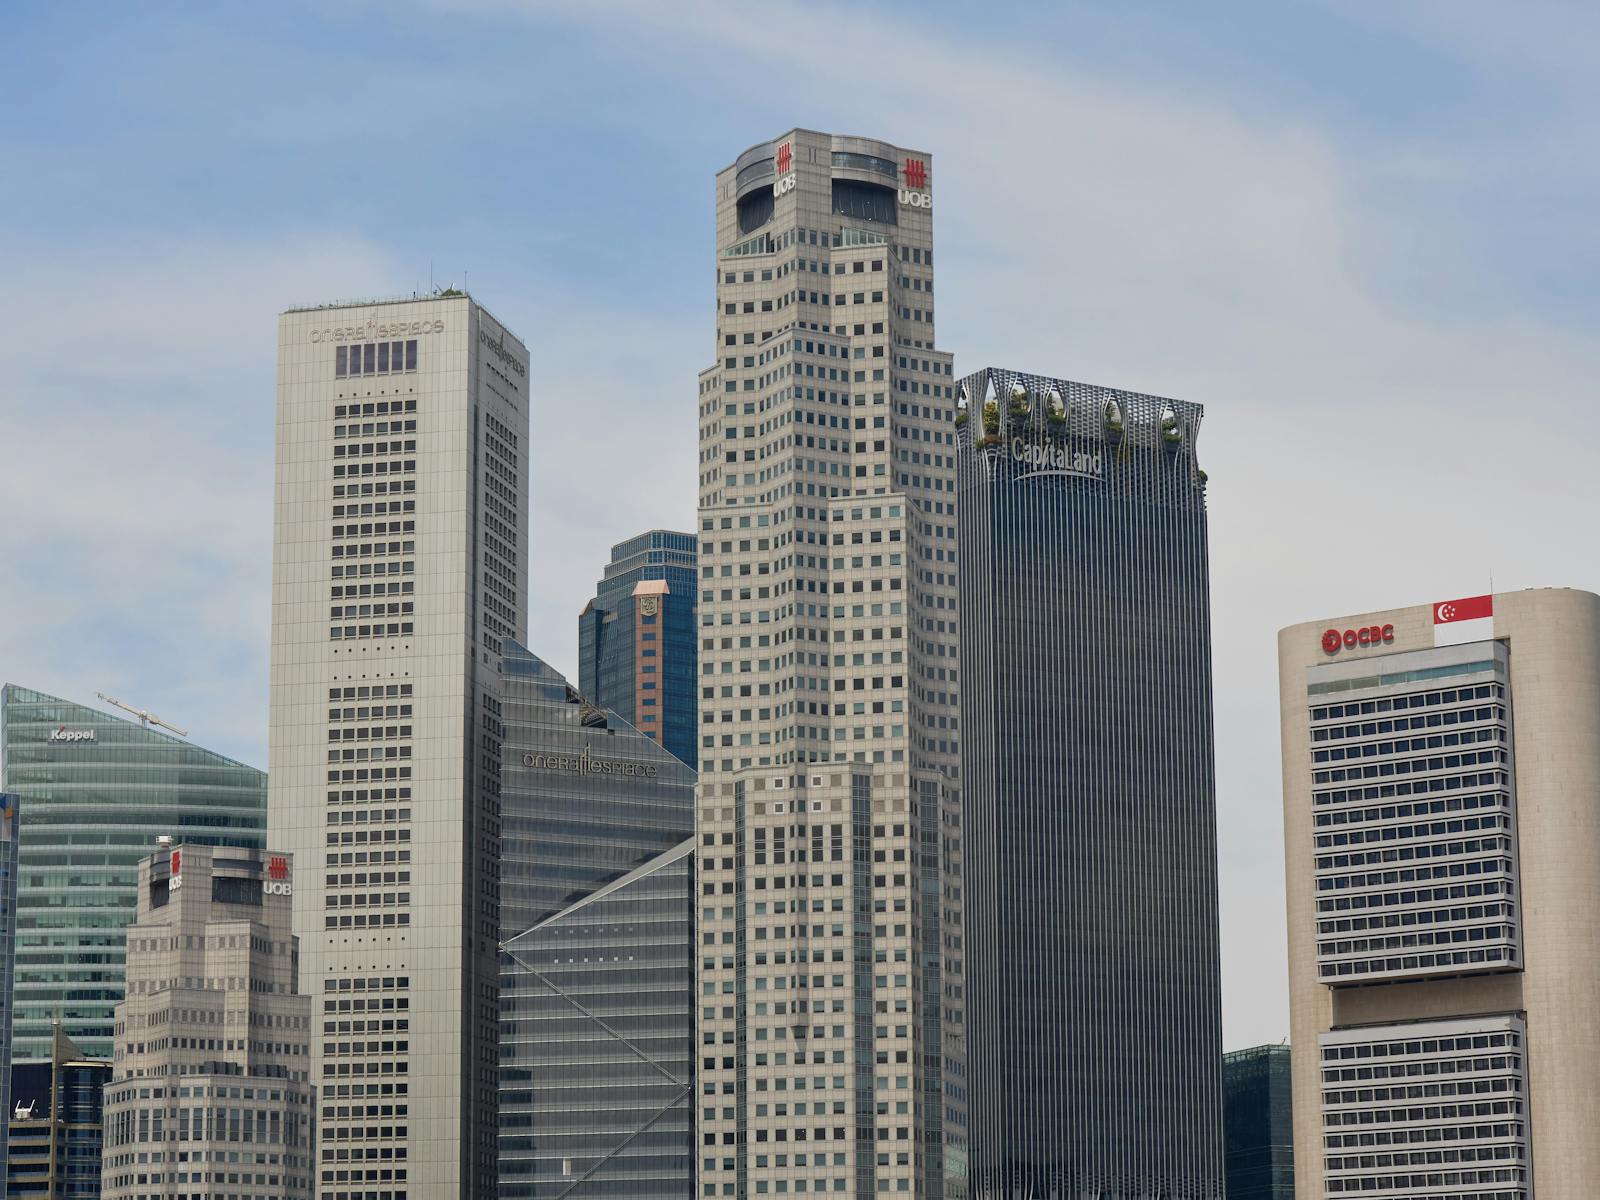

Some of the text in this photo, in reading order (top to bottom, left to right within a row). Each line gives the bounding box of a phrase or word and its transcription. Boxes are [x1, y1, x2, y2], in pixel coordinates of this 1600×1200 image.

[774, 173, 796, 197] UOB
[898, 189, 932, 208] UOB
[1012, 436, 1102, 475] CapitaLand
[1343, 624, 1394, 645] OCBC
[51, 729, 95, 742] Keppel
[263, 881, 292, 896] UOB
